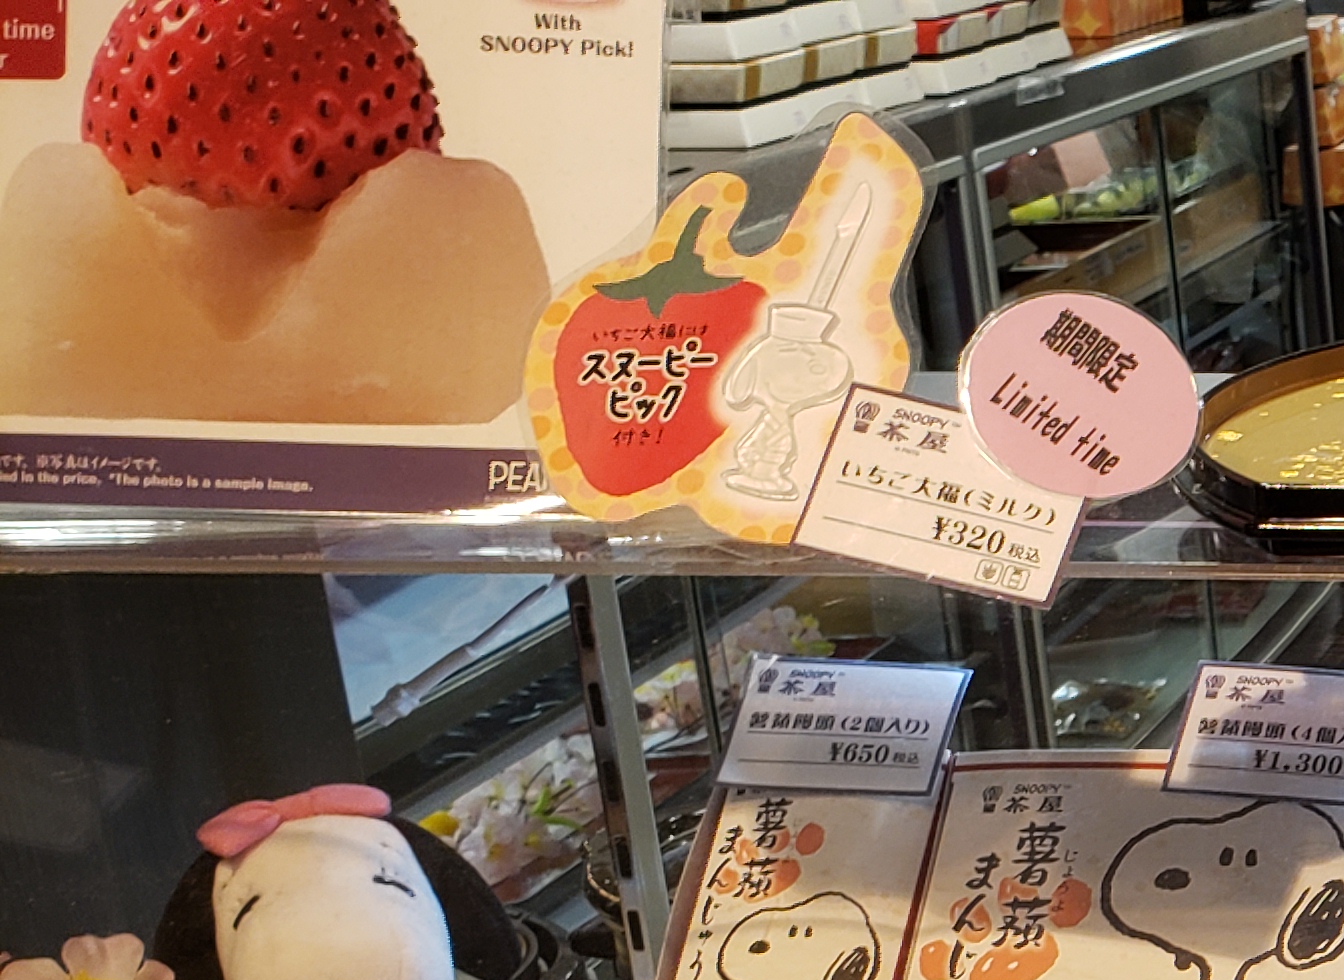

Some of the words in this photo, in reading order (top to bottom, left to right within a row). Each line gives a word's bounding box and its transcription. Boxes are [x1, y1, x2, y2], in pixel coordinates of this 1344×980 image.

[3, 18, 55, 40] time
[534, 13, 582, 31] With
[480, 35, 574, 55] SNOOPY
[581, 39, 634, 57] Pick!
[580, 339, 716, 382] スヌーピー
[1039, 308, 1139, 394] 期間限定
[608, 381, 684, 420] ピック
[892, 408, 950, 428] SNOOPY
[990, 372, 1080, 445] Limited
[1070, 427, 1121, 475] time
[878, 421, 951, 453] 茶屋
[841, 460, 1056, 526] いちご大福(ミルク)
[932, 516, 1006, 554] ¥320
[1008, 542, 1041, 563] 税込
[778, 680, 837, 696] 茶屋
[1236, 675, 1283, 685] SNOOPY
[1225, 686, 1286, 704] 茶屋
[830, 741, 890, 764] ¥650
[1013, 784, 1062, 795] SNOOPY
[1003, 796, 1064, 813] 茶屋
[991, 821, 1066, 949] 薯蕷
